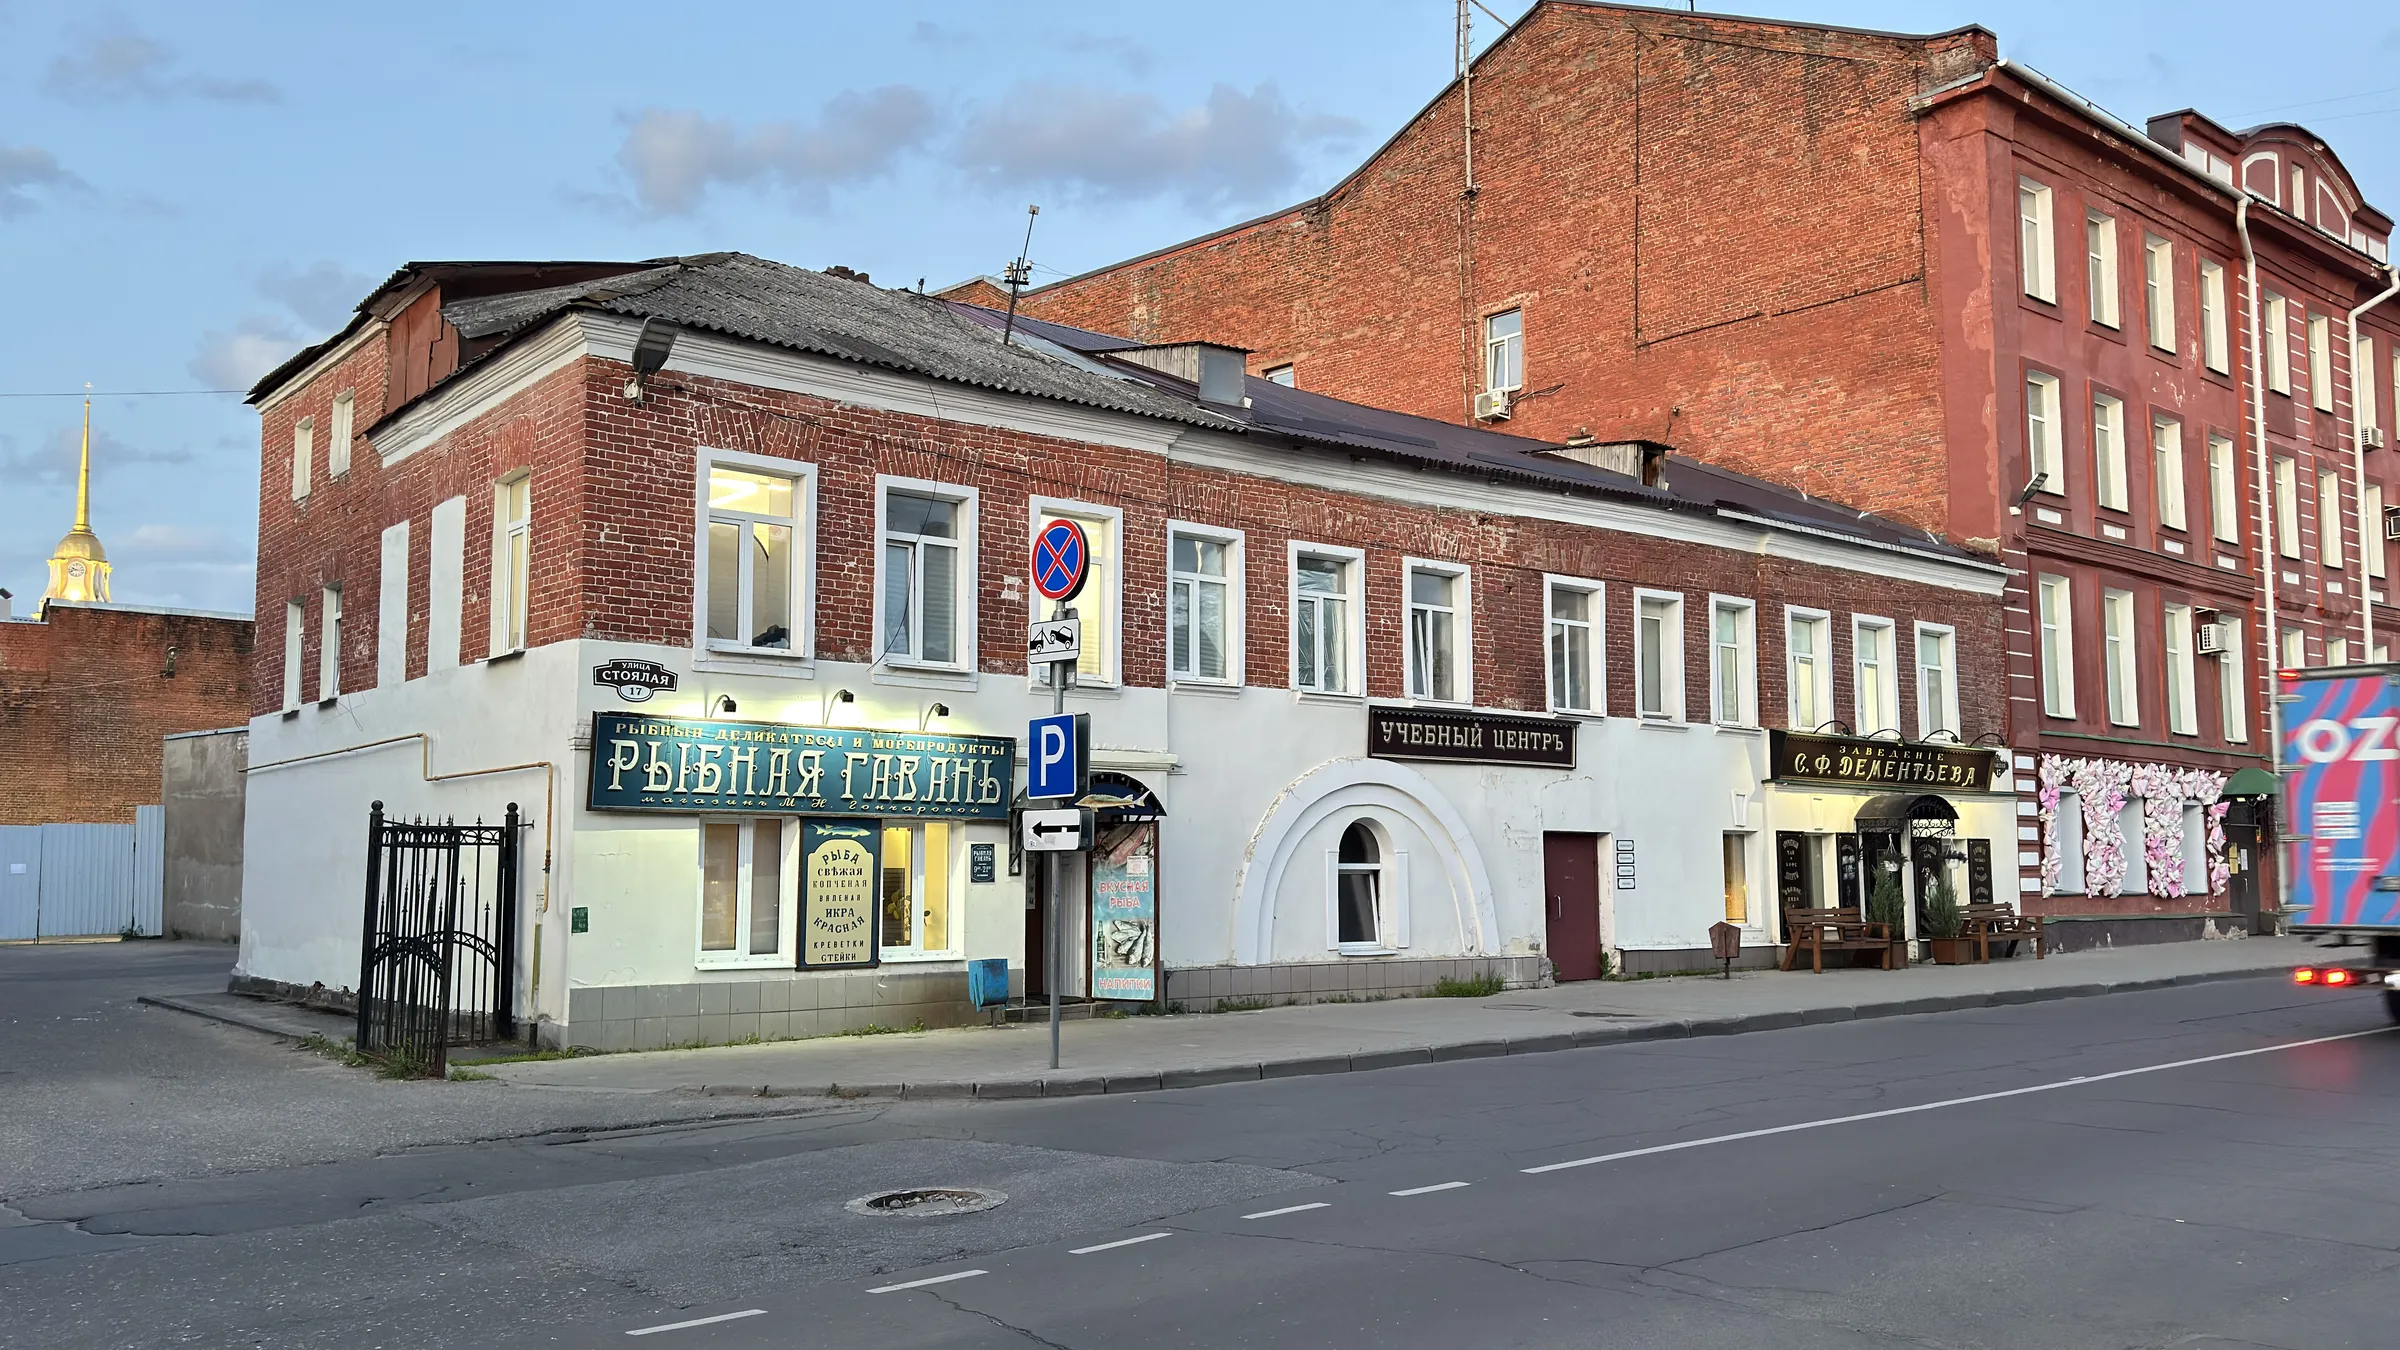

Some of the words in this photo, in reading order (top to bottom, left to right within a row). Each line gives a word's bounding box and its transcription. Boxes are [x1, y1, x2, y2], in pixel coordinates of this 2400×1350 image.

[621, 662, 651, 671] УЛИЦА
[602, 670, 670, 686] СТОЯЛАЯ
[629, 687, 643, 696] 17
[714, 728, 844, 750] ДЕЛИКАТЕСЫ
[853, 737, 863, 748] И
[873, 738, 1006, 757] МОРЕПРОДУКТЫ
[1381, 722, 1484, 749] УЧЕБНЫЙ
[1493, 729, 1564, 752] ЦЕНТРЪ
[2297, 716, 2400, 763] OZ
[1839, 745, 1945, 762] ЗАВЕДЕНІЕ
[606, 737, 826, 799] РЫБНАЯ
[839, 750, 1002, 805] ГАВАНЬ
[1814, 754, 1832, 775] Ф.
[1838, 756, 1976, 787] ДЕМЕНТЬЕВА
[821, 849, 860, 865] РЫБА
[812, 879, 867, 889] КОПЧЕНАЯ
[1099, 880, 1149, 894] ВКУСНАЯ
[819, 894, 861, 902] ВЯЛЕНАЯ
[1109, 897, 1140, 909] РЫБА
[825, 907, 855, 918] ИКРА
[813, 915, 865, 934] КРАСНАЯ
[813, 941, 864, 949] КРЕВЕТКИ
[820, 951, 857, 963] СТЕЙКИ
[1098, 977, 1151, 991] НАПИТКИ
